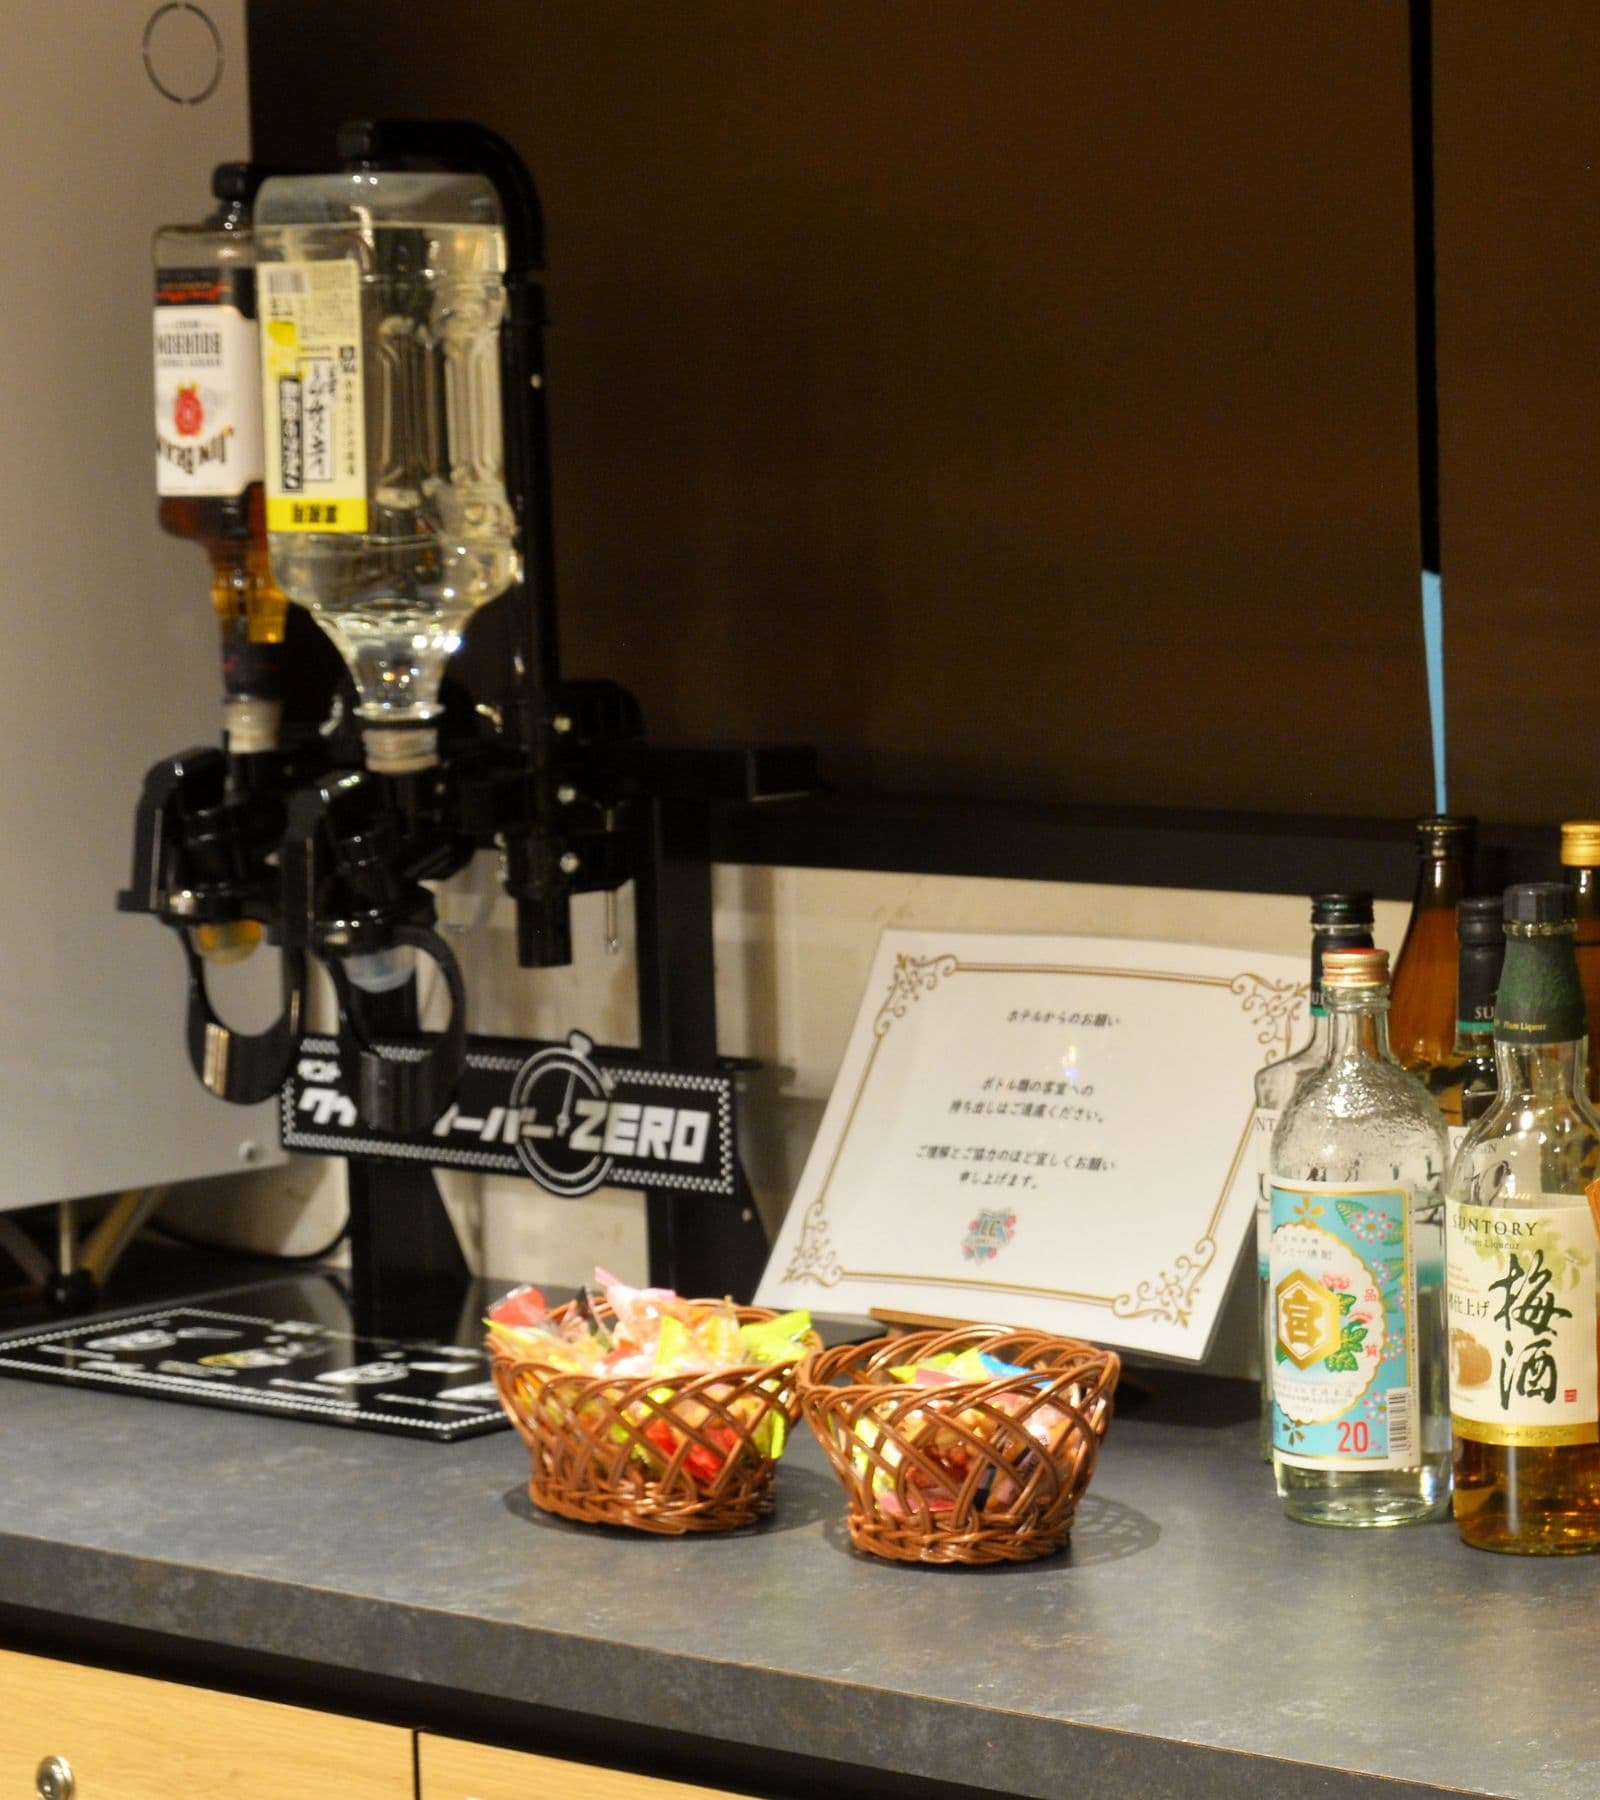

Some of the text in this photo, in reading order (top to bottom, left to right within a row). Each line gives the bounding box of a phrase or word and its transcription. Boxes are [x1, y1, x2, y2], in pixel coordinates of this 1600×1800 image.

[568, 1098, 711, 1165] ZERO
[1453, 1214, 1537, 1237] SUNTORY
[1484, 1237, 1521, 1250] Liqueur
[1488, 1249, 1573, 1411] 梅酒
